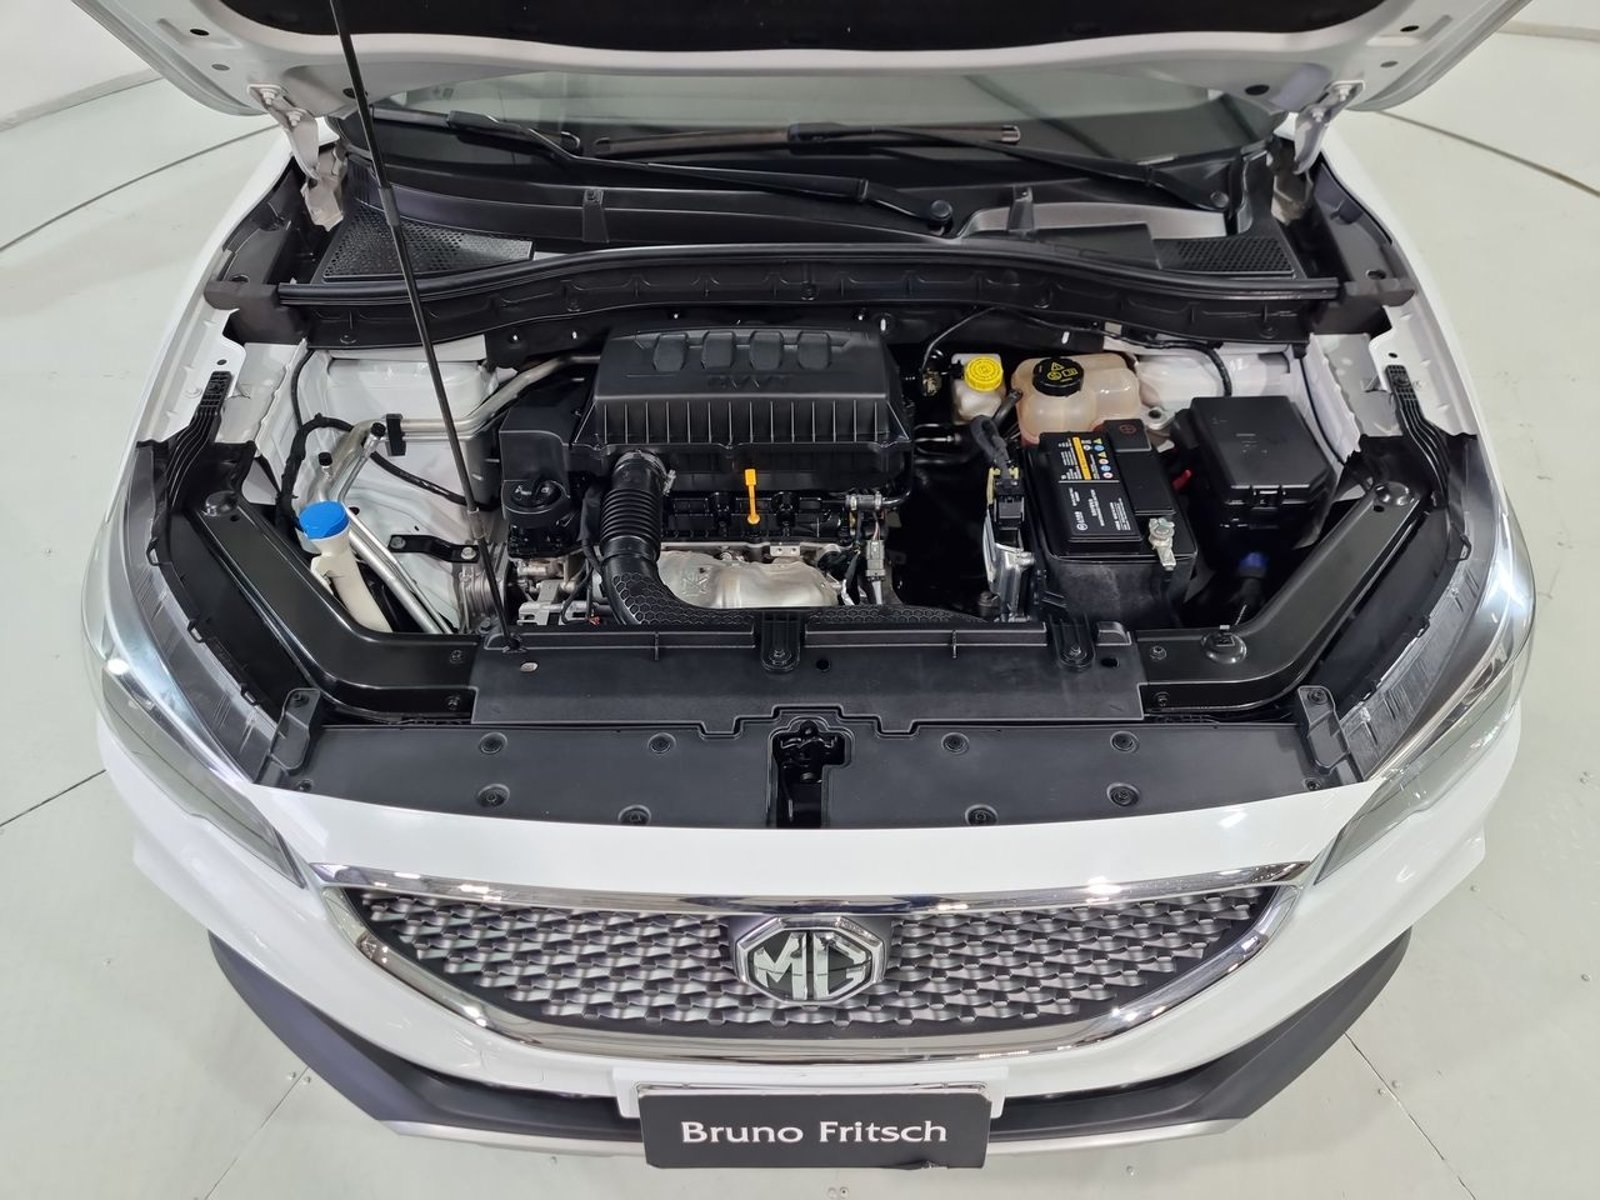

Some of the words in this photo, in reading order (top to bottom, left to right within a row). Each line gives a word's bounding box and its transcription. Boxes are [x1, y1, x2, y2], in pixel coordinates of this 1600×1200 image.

[754, 931, 867, 1001] MG
[681, 1121, 804, 1143] Bruno
[820, 1120, 948, 1143] Fritsch
